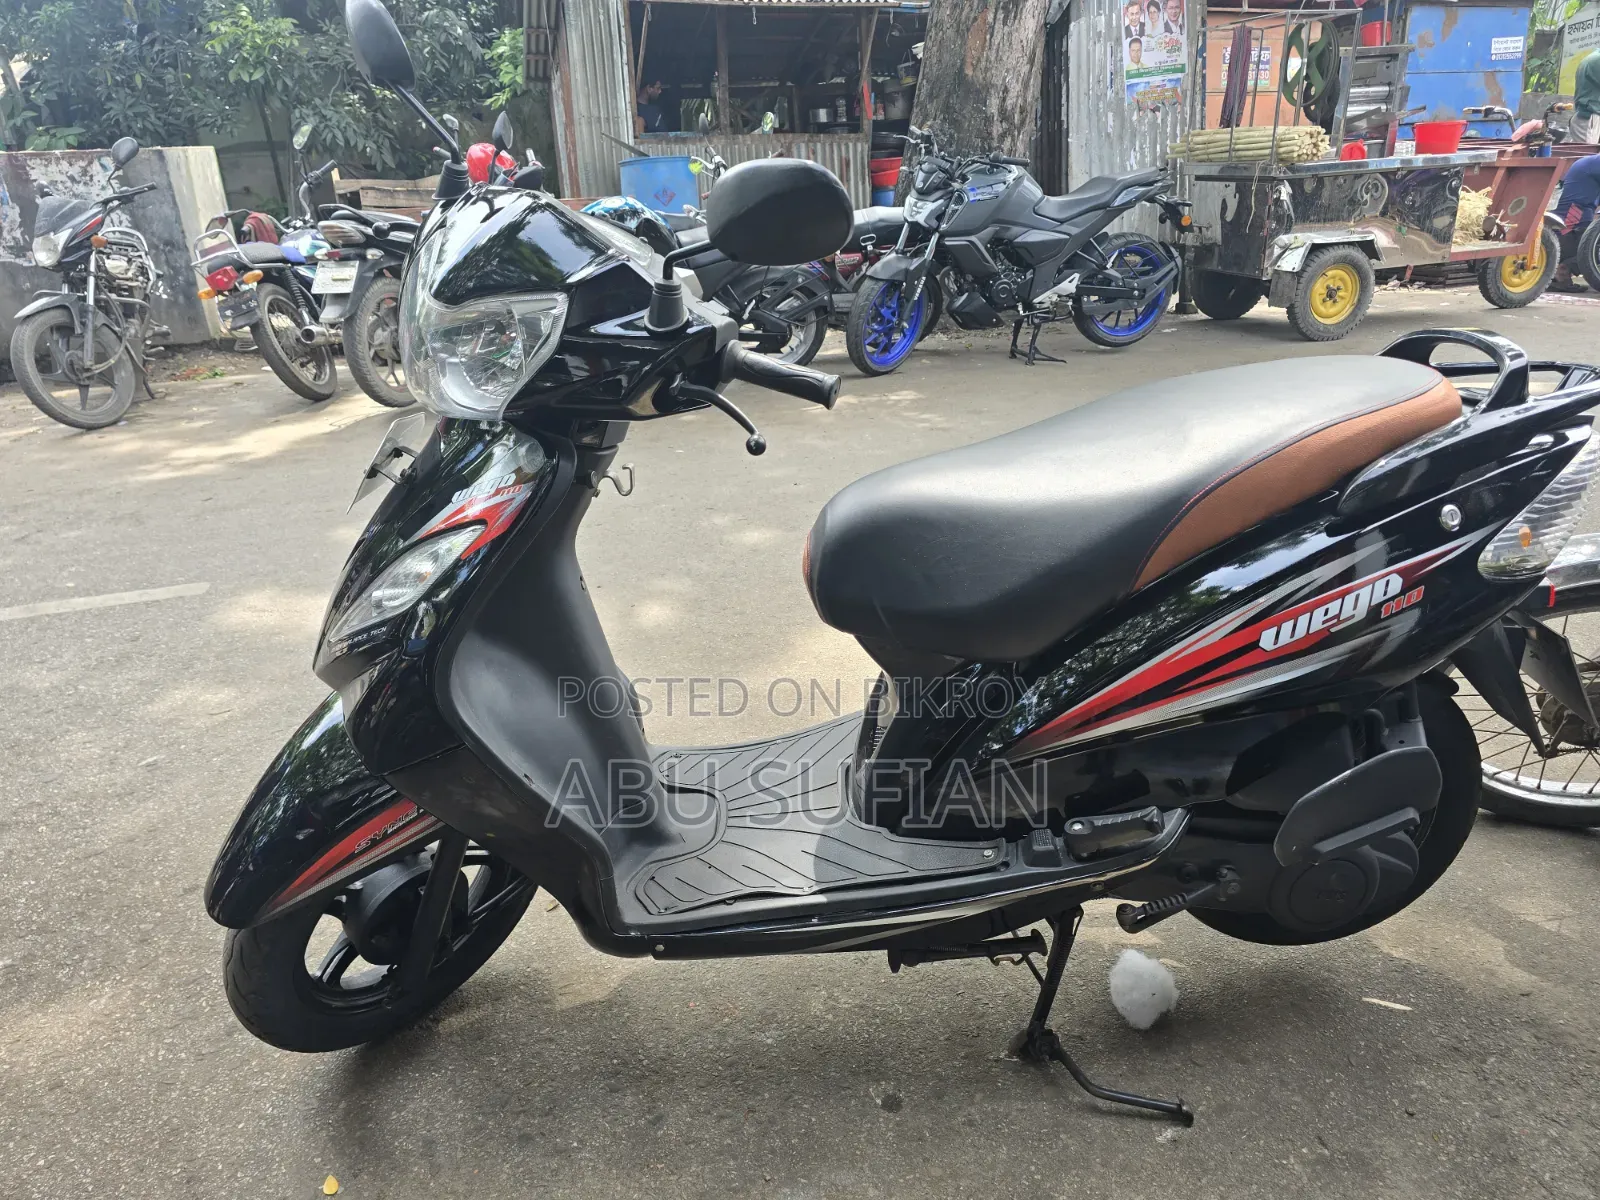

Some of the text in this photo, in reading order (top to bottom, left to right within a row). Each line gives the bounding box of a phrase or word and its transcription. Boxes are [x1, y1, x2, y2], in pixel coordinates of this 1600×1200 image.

[1259, 573, 1425, 651] wego 110
[355, 805, 418, 853] SYNC
